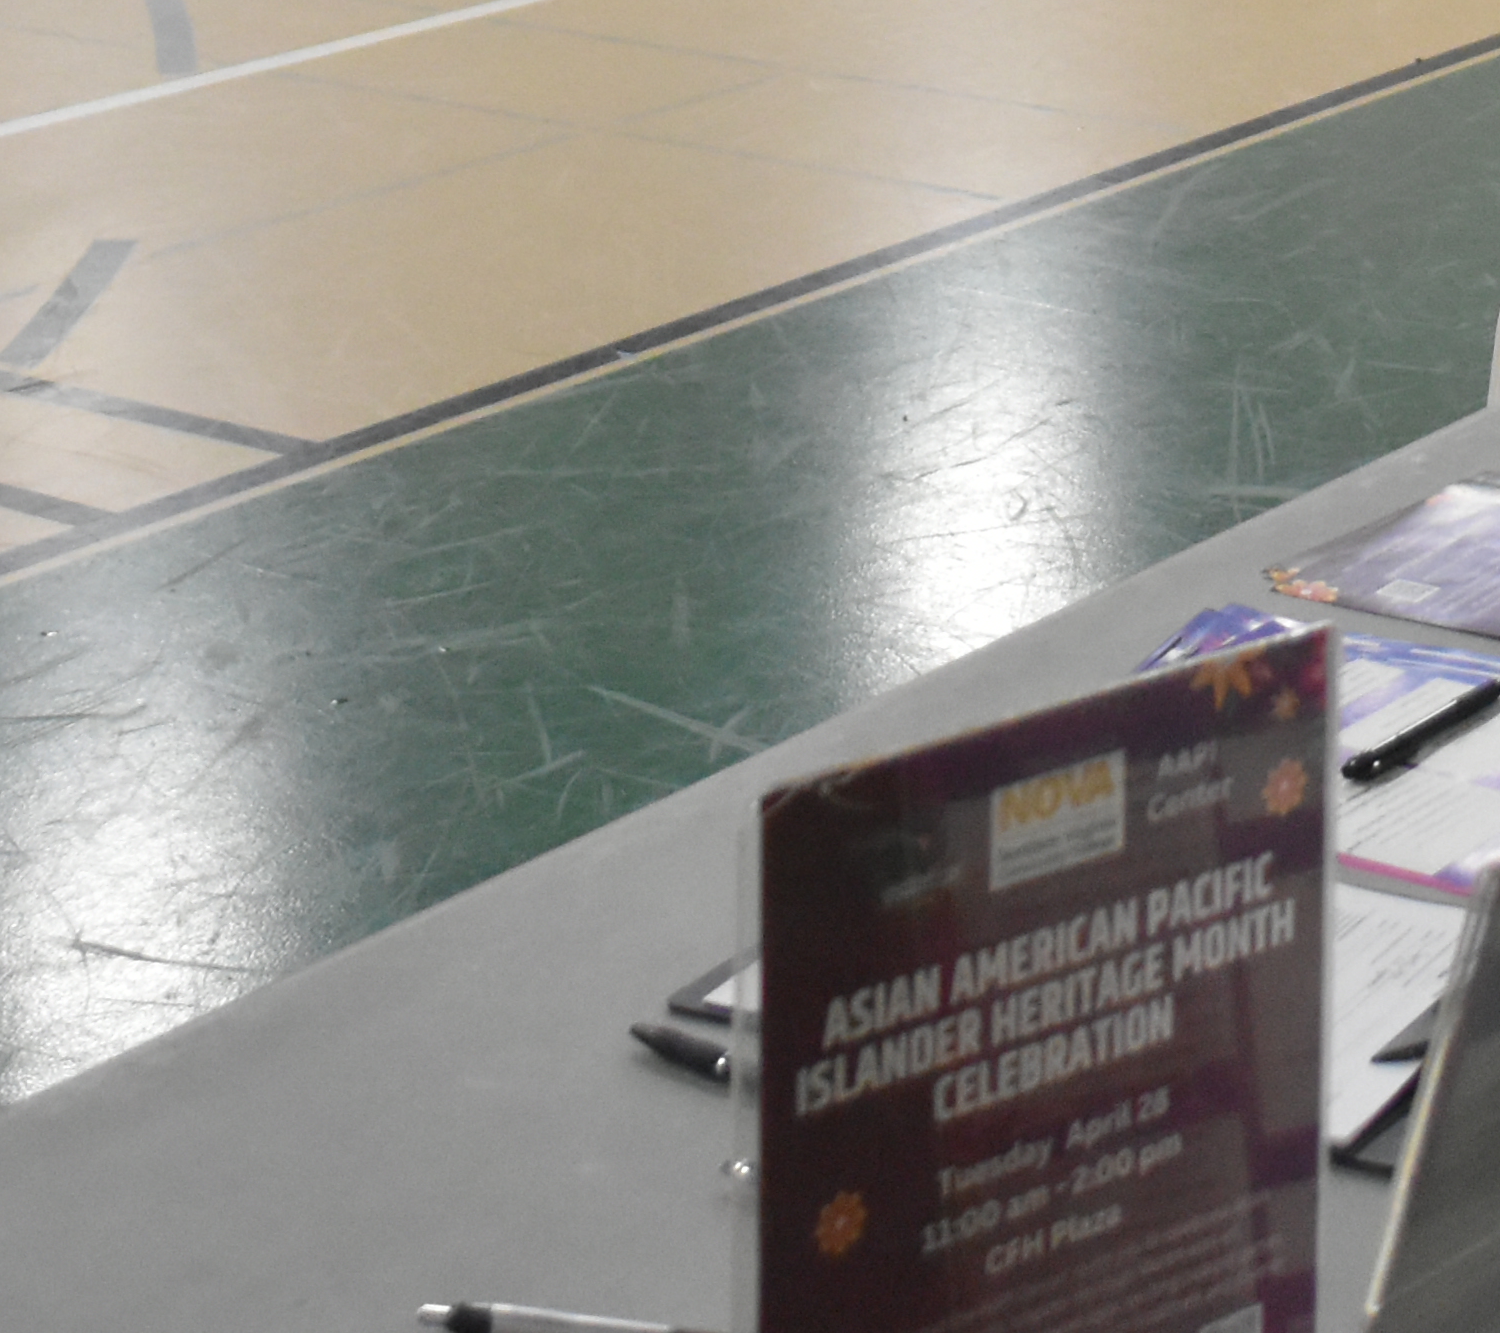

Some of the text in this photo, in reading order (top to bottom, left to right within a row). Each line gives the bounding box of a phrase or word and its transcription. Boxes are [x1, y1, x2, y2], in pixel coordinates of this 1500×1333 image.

[996, 760, 1116, 833] NOVA
[1147, 776, 1235, 822] Center
[821, 964, 942, 1050] ASIAN
[950, 896, 1140, 1006] AMERICAN
[1147, 850, 1274, 934] PACIFIC
[795, 1012, 983, 1118] ISLANDER
[991, 943, 1165, 1046] HERITAGE
[1171, 898, 1296, 984] MONTH
[933, 993, 1176, 1122] CELEBRATION
[938, 1136, 1056, 1199] Tuesday
[1064, 1099, 1133, 1153] April
[922, 1198, 1003, 1255] 11:00
